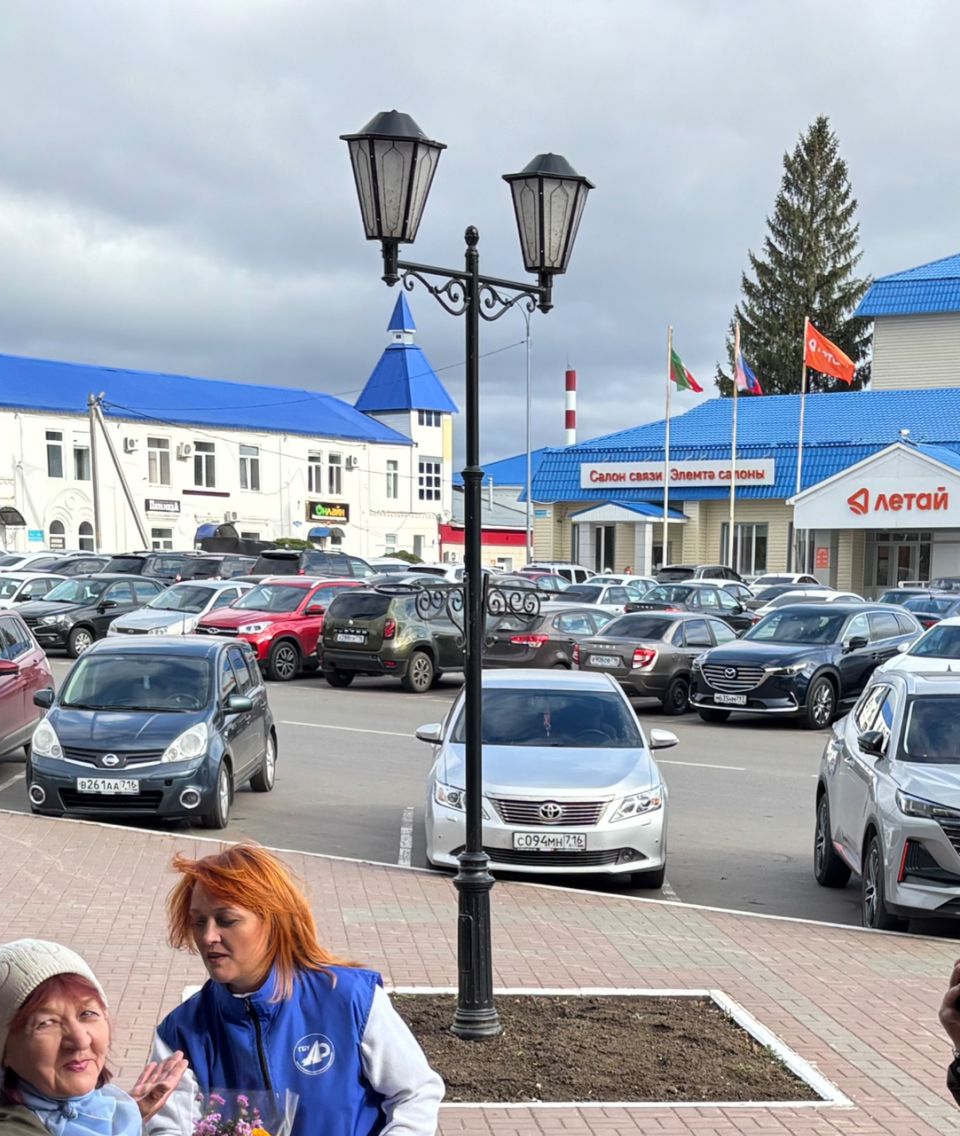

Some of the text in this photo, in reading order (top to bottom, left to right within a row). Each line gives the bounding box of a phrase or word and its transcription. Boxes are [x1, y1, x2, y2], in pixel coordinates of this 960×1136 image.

[590, 469, 626, 482] Салон
[629, 471, 663, 482] связи
[670, 468, 715, 481] Элемтә
[874, 486, 949, 511] летай
